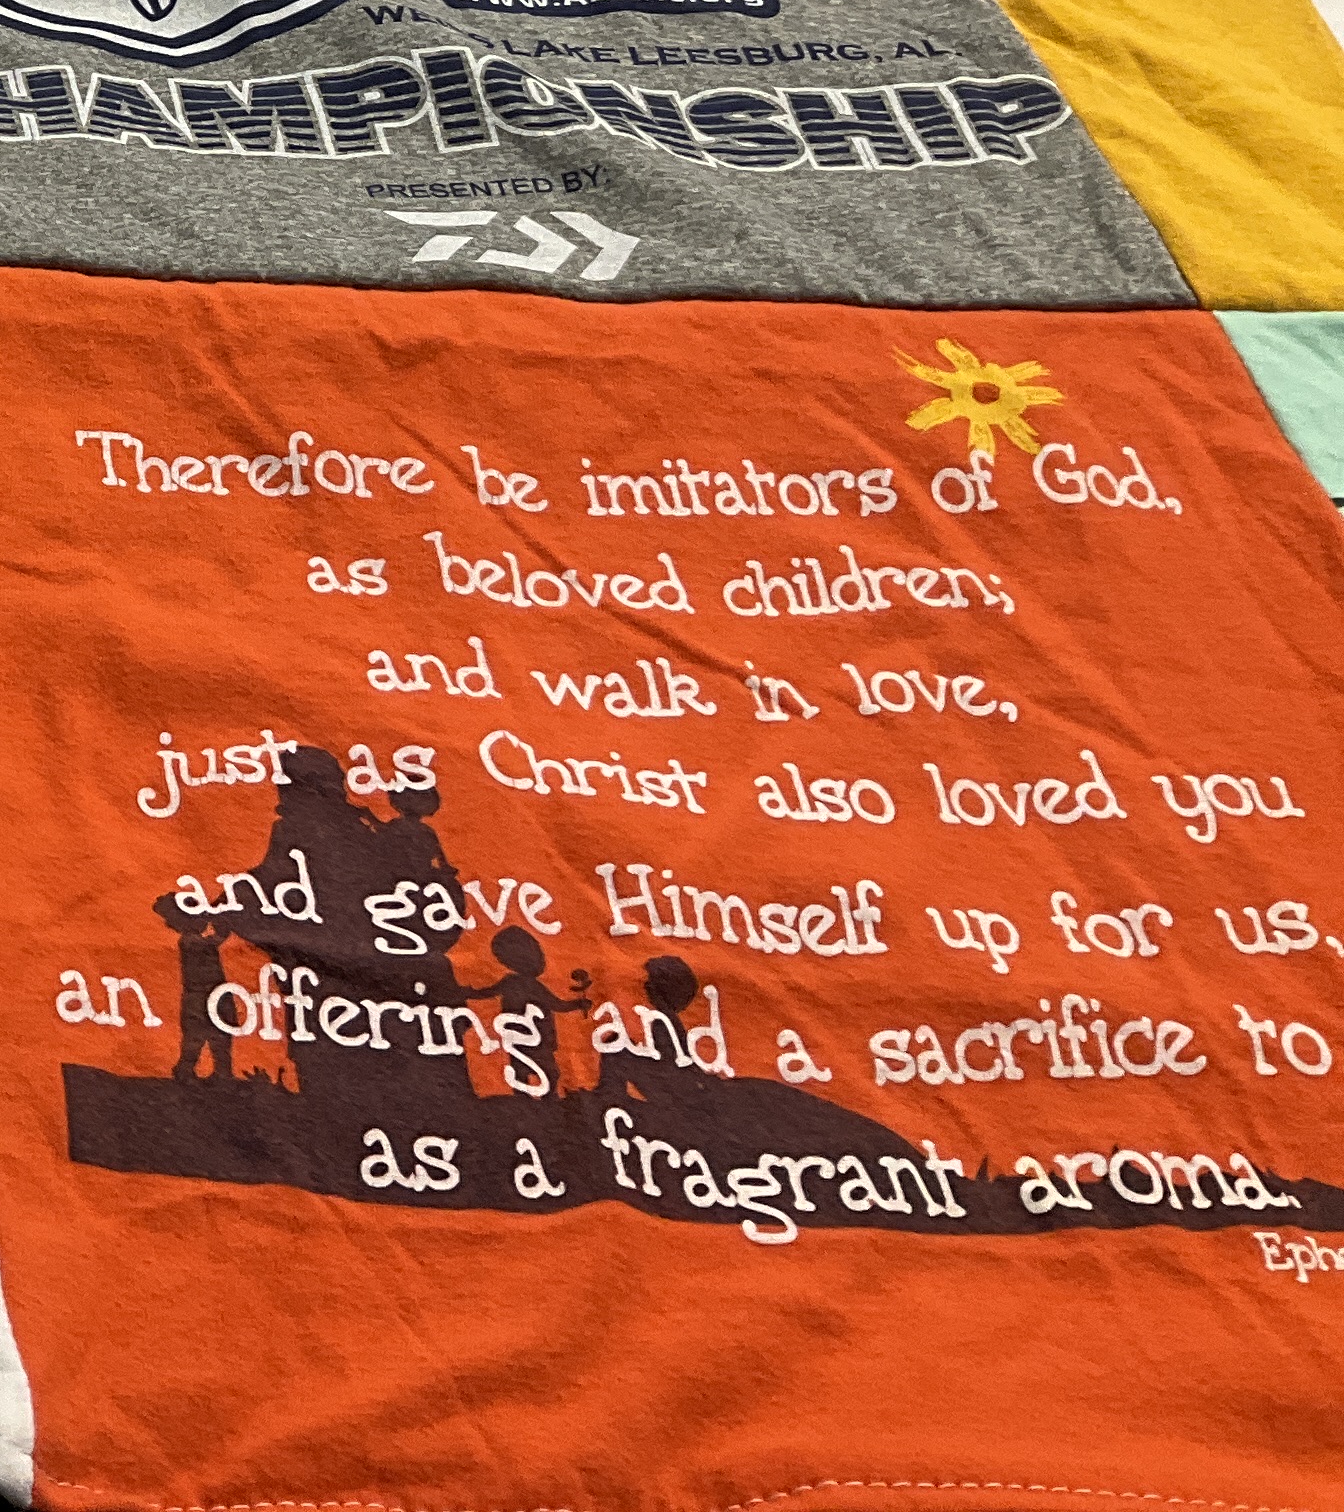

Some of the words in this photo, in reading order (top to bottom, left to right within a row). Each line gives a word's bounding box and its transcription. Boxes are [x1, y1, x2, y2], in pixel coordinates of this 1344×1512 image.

[500, 36, 622, 65] LAKE
[630, 40, 885, 67] LEESBURG,
[894, 39, 965, 60] AL.
[365, 171, 553, 203] PRESENTED
[562, 165, 614, 194] BY:
[75, 429, 435, 499] Therefore
[466, 445, 549, 514] be
[581, 455, 900, 520] imitators
[930, 450, 1001, 514] of
[1031, 445, 1184, 517] God,
[305, 551, 388, 598] as
[422, 533, 695, 616] beloved
[722, 544, 1016, 620] children;
[367, 638, 501, 701] and
[531, 658, 717, 719] walk
[745, 661, 820, 722] in
[856, 661, 1020, 722] love,
[136, 728, 299, 819] just
[346, 737, 438, 796] as
[477, 728, 708, 817] Christ
[753, 764, 896, 826] also
[923, 751, 1127, 829] loved
[1151, 770, 1306, 845] you
[173, 849, 323, 926] and
[363, 874, 562, 955] gave
[596, 861, 885, 957] Himself
[927, 903, 1021, 975] up
[1052, 892, 1174, 958] for
[54, 965, 164, 1030] an
[206, 968, 552, 1099] offering
[588, 986, 733, 1080] and
[776, 1031, 833, 1085] a
[872, 996, 1209, 1088] sacrifice
[1237, 1004, 1336, 1078] to
[360, 1127, 461, 1195] as
[513, 1140, 566, 1200] a
[601, 1107, 968, 1246] fragrant
[1014, 1148, 1303, 1212] aroma.
